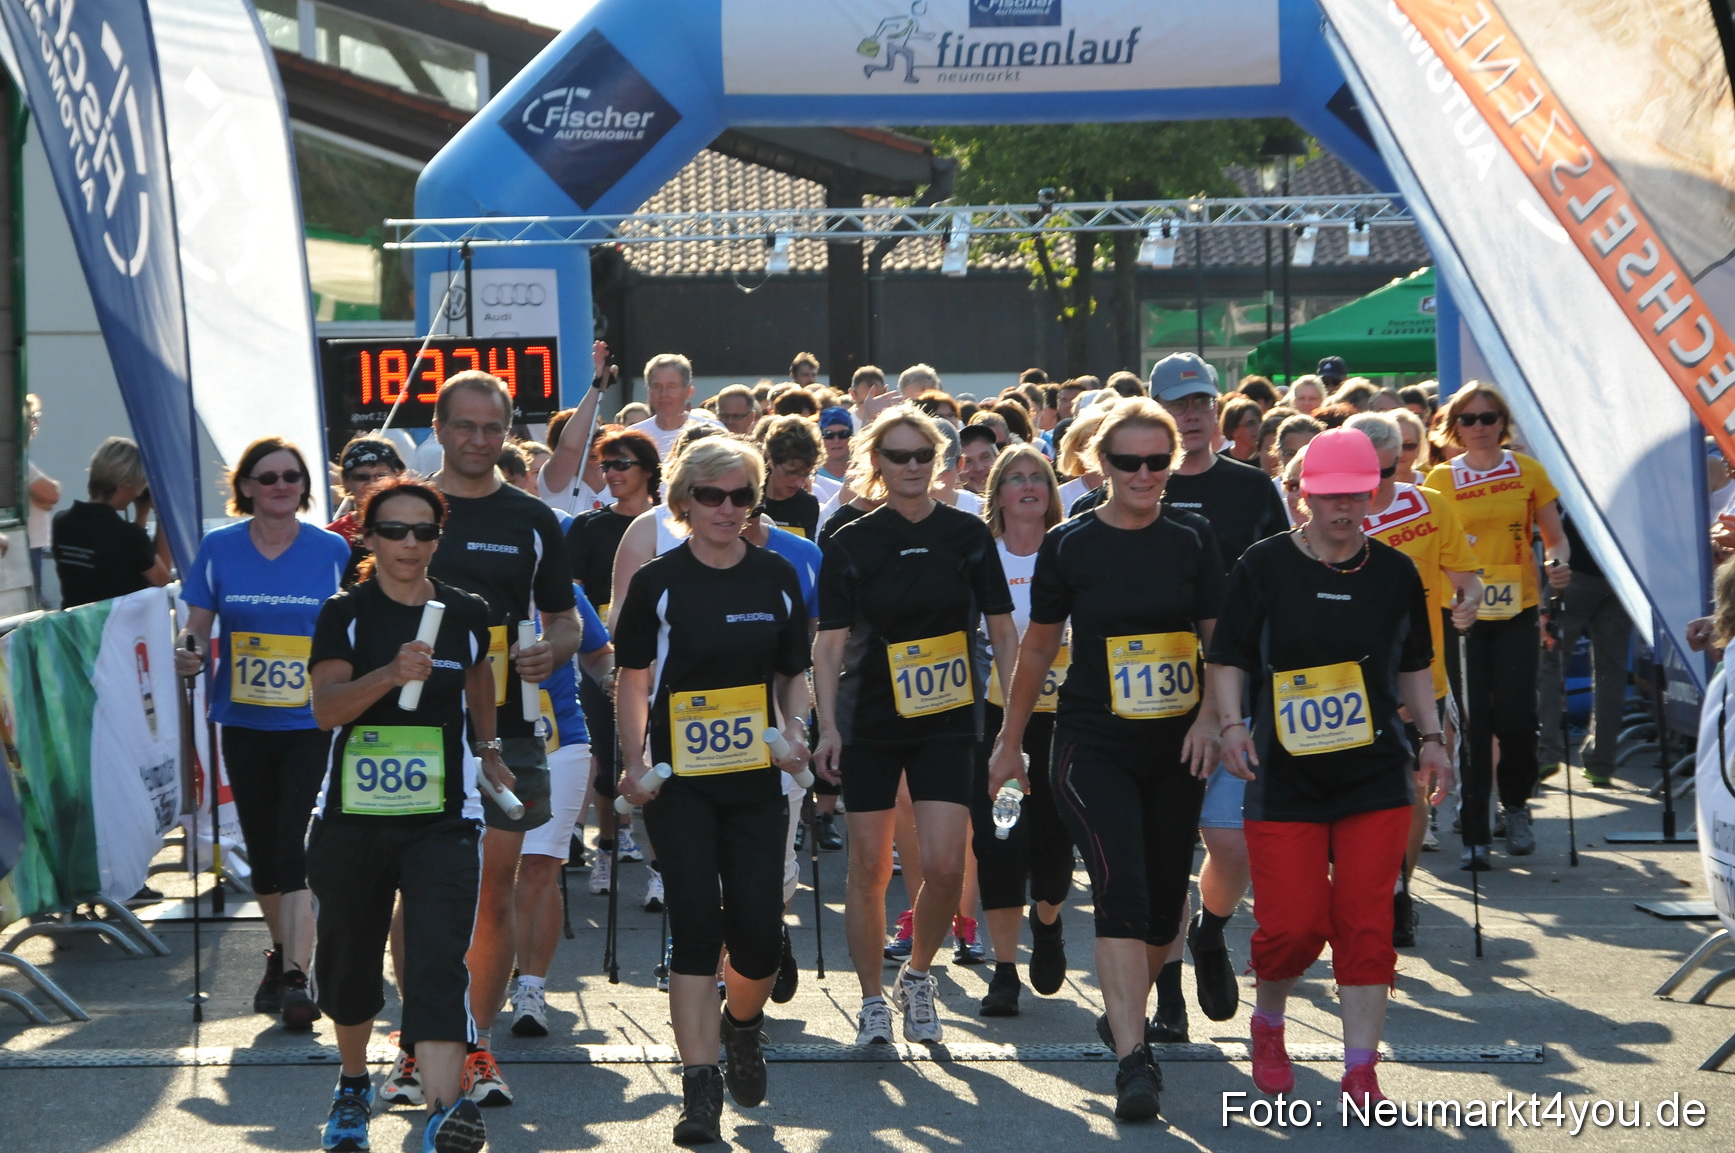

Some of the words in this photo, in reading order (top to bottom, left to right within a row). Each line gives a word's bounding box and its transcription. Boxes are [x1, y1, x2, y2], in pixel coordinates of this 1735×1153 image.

[936, 26, 1142, 68] firmenlauf
[937, 69, 1021, 83] neumarkt
[544, 104, 655, 128] Fischer
[553, 129, 646, 141] AUTOMOBILE
[483, 313, 513, 321] Audi
[1455, 488, 1487, 501] MAX
[1490, 481, 1525, 495] BÖGL
[475, 542, 519, 554] PFLEIDERER
[1387, 521, 1439, 548] BÖGL
[225, 592, 320, 606] energiegeladen
[235, 656, 306, 690] 1263
[896, 658, 967, 699] 1070
[1114, 661, 1194, 699] 1130
[1279, 692, 1367, 735] 1092
[685, 716, 754, 755] 985
[355, 757, 428, 794] 986
